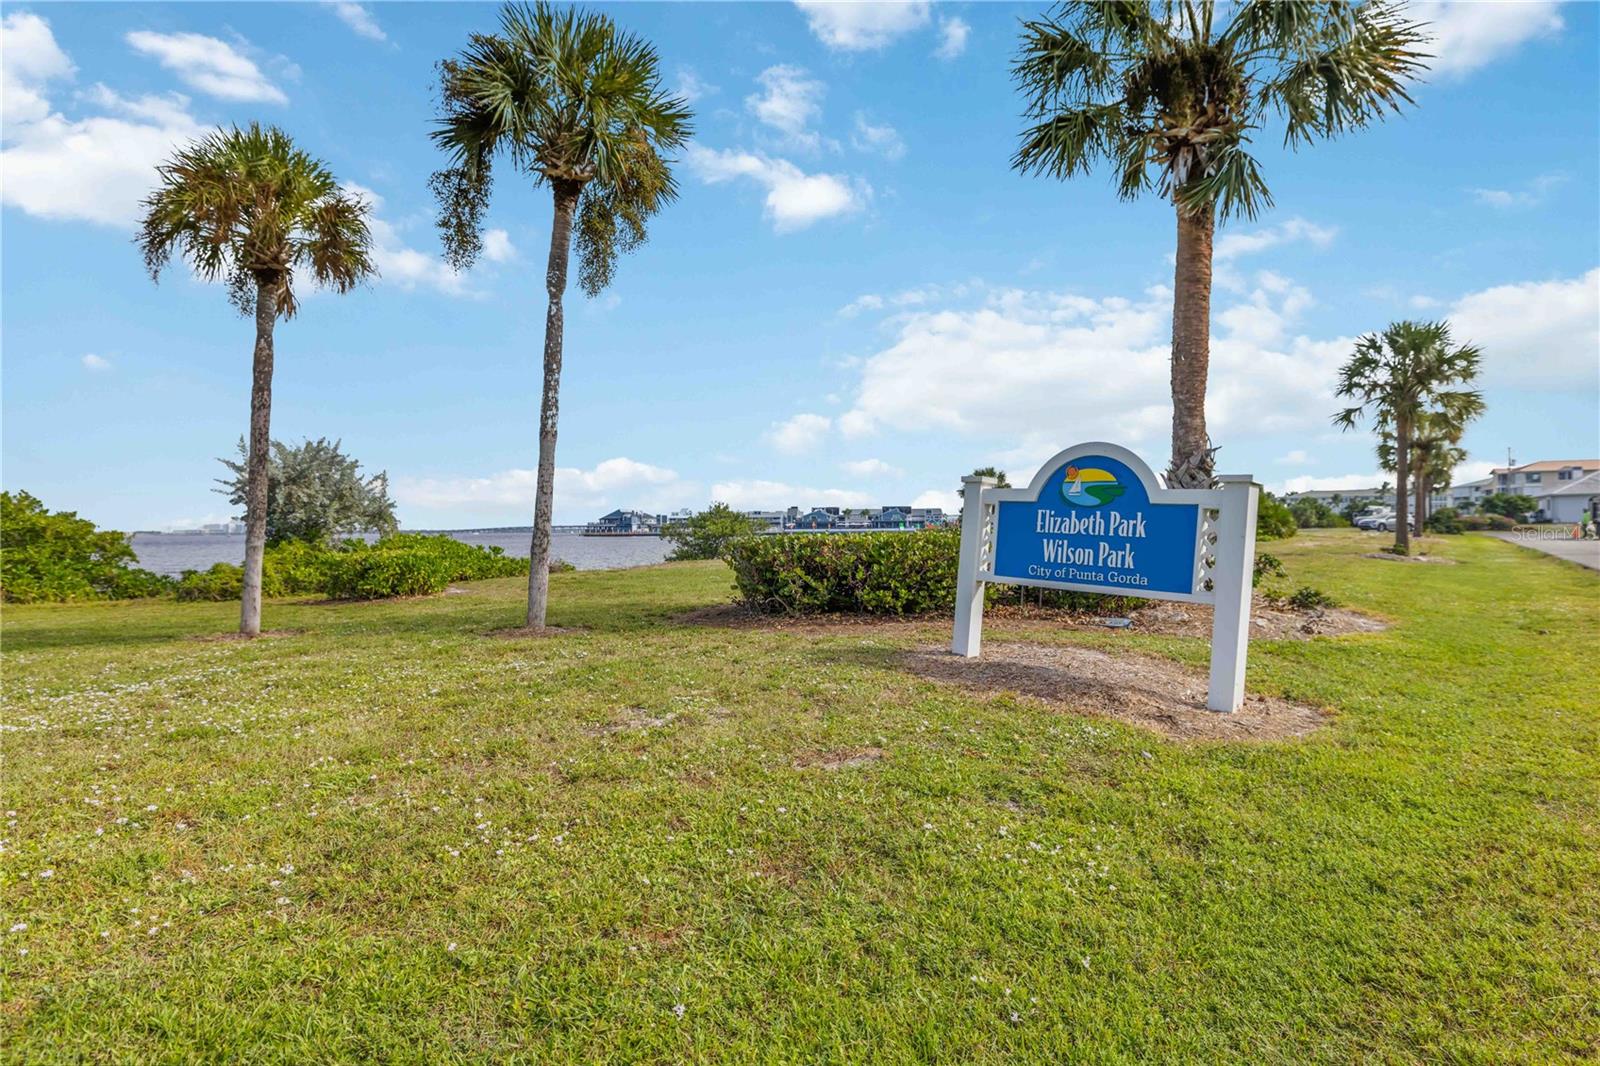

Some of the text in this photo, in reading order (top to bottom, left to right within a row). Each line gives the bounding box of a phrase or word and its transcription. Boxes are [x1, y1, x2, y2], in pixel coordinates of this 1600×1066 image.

[1036, 509, 1146, 538] Elizabeth Park
[1042, 539, 1135, 569] Wilson Park
[1028, 564, 1149, 586] City of Punta Gorda
